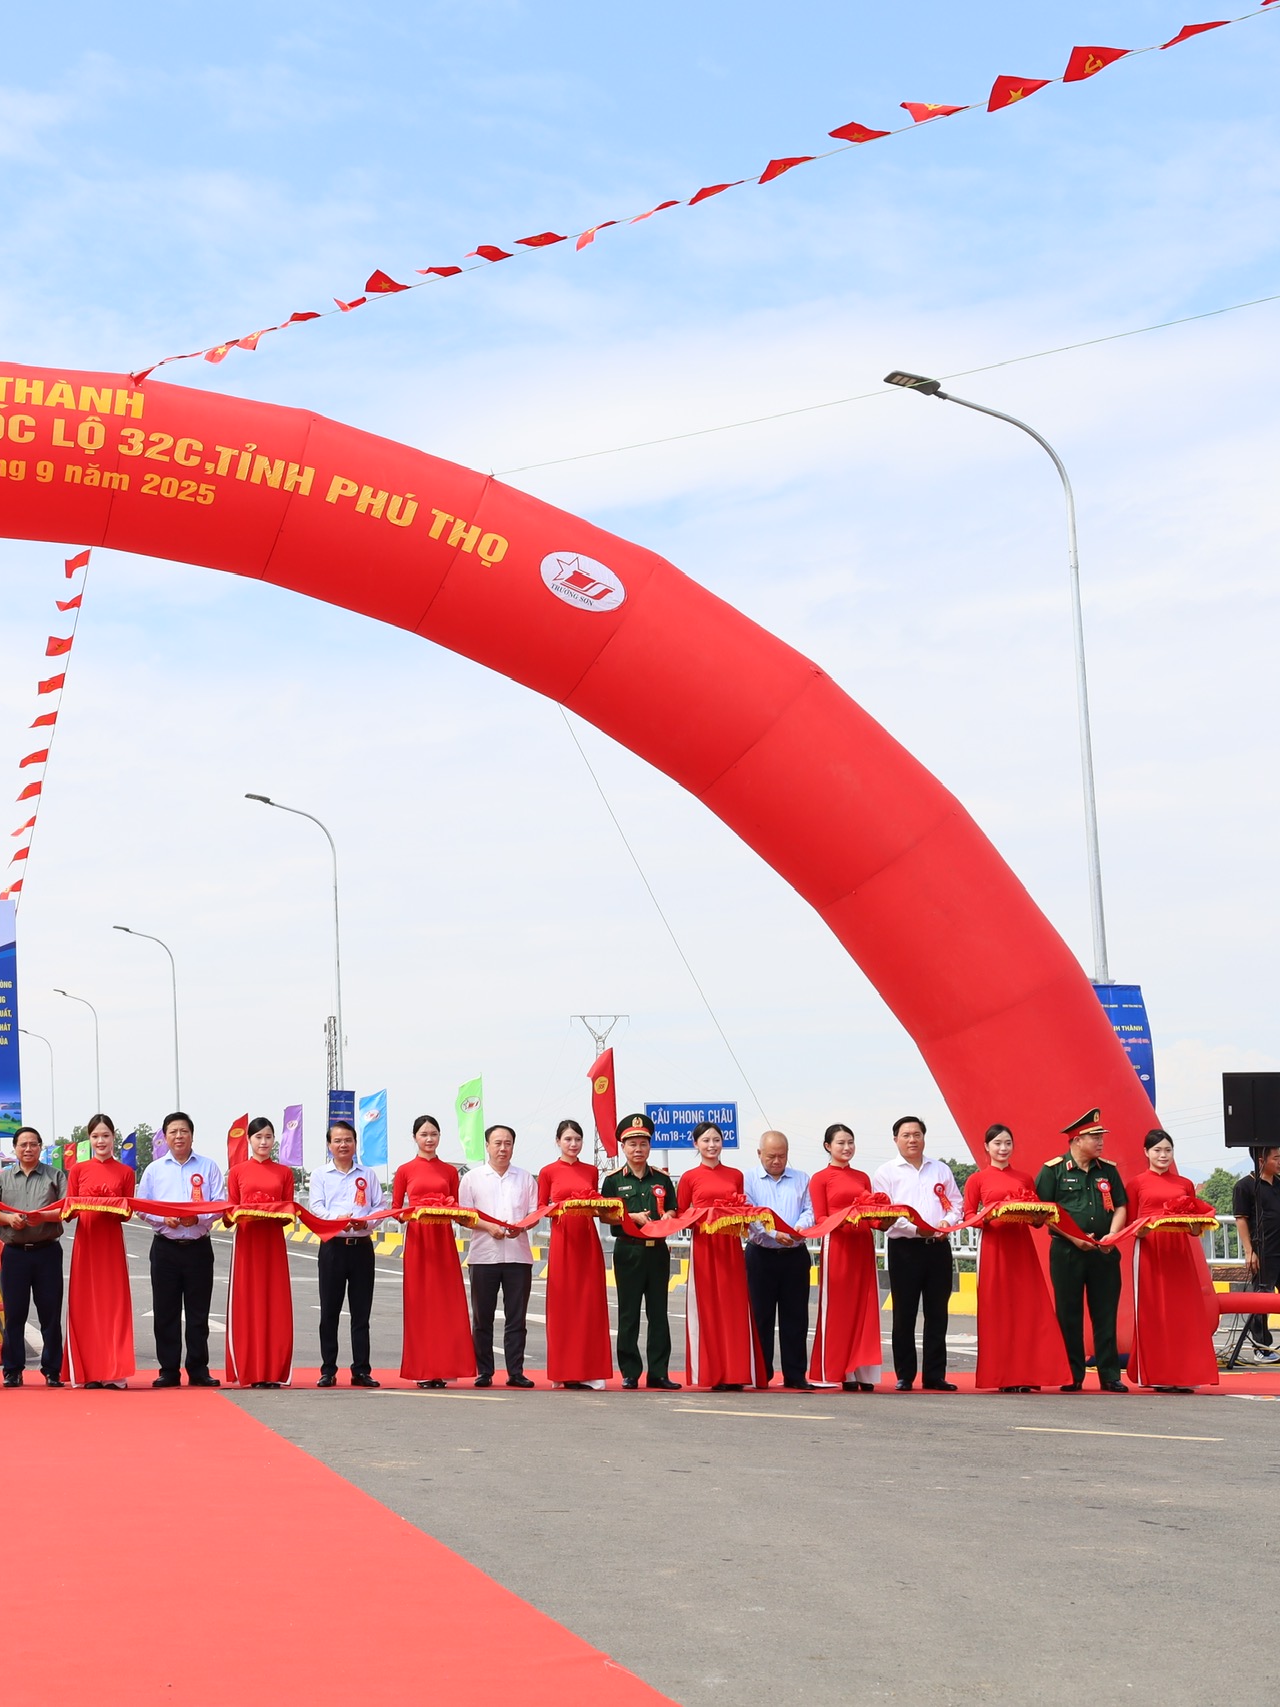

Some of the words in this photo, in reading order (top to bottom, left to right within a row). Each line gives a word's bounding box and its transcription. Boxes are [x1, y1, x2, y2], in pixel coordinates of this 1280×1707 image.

[36, 460, 54, 482] 9
[64, 462, 131, 492] năm
[139, 473, 217, 506] 2025
[51, 415, 106, 456] LỘ
[325, 475, 419, 528] PHÚ
[428, 508, 510, 568] THỌ
[651, 1107, 670, 1124] CẦU
[673, 1110, 704, 1124] PHONG
[708, 1108, 733, 1124] CHÂU
[655, 1130, 694, 1141] Km18+2
